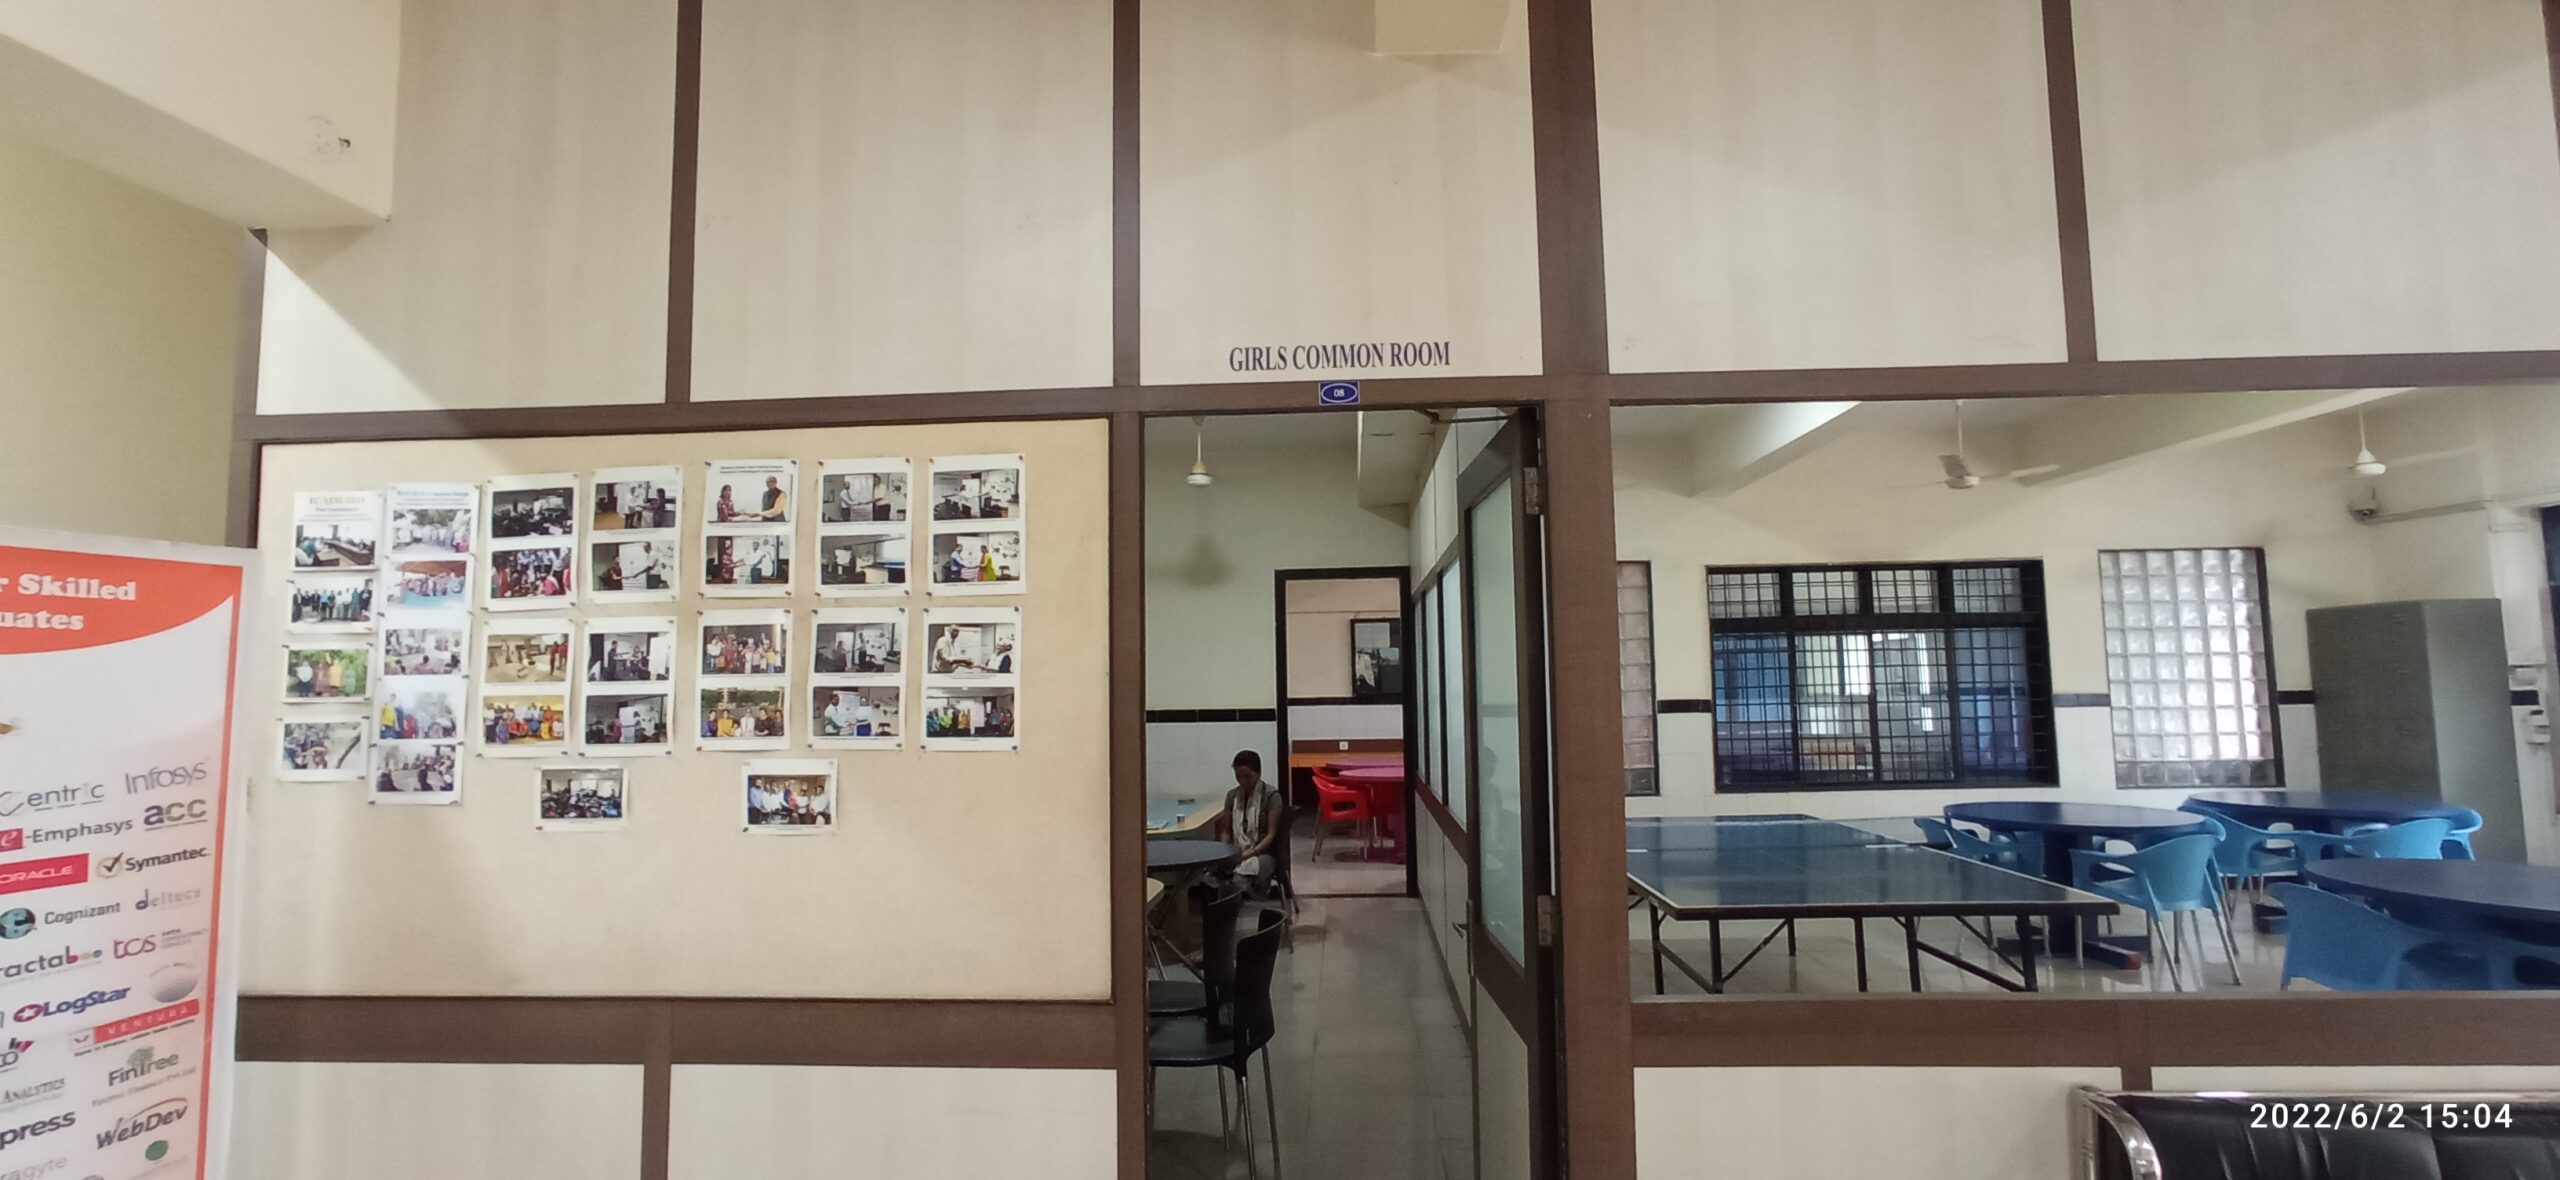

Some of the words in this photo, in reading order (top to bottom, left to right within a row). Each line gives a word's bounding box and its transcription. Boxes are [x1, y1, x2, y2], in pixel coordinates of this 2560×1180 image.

[1229, 346, 1287, 372] GIRLS
[1292, 342, 1384, 370] COMMON
[1390, 341, 1451, 367] ROOM
[18, 573, 136, 601] Skilled
[125, 762, 207, 795] Infosys
[143, 799, 206, 826] acc
[124, 847, 208, 871] Symantec
[44, 902, 120, 925] Cognizant
[43, 987, 131, 1014] LogStar
[96, 1105, 188, 1150] WebDev
